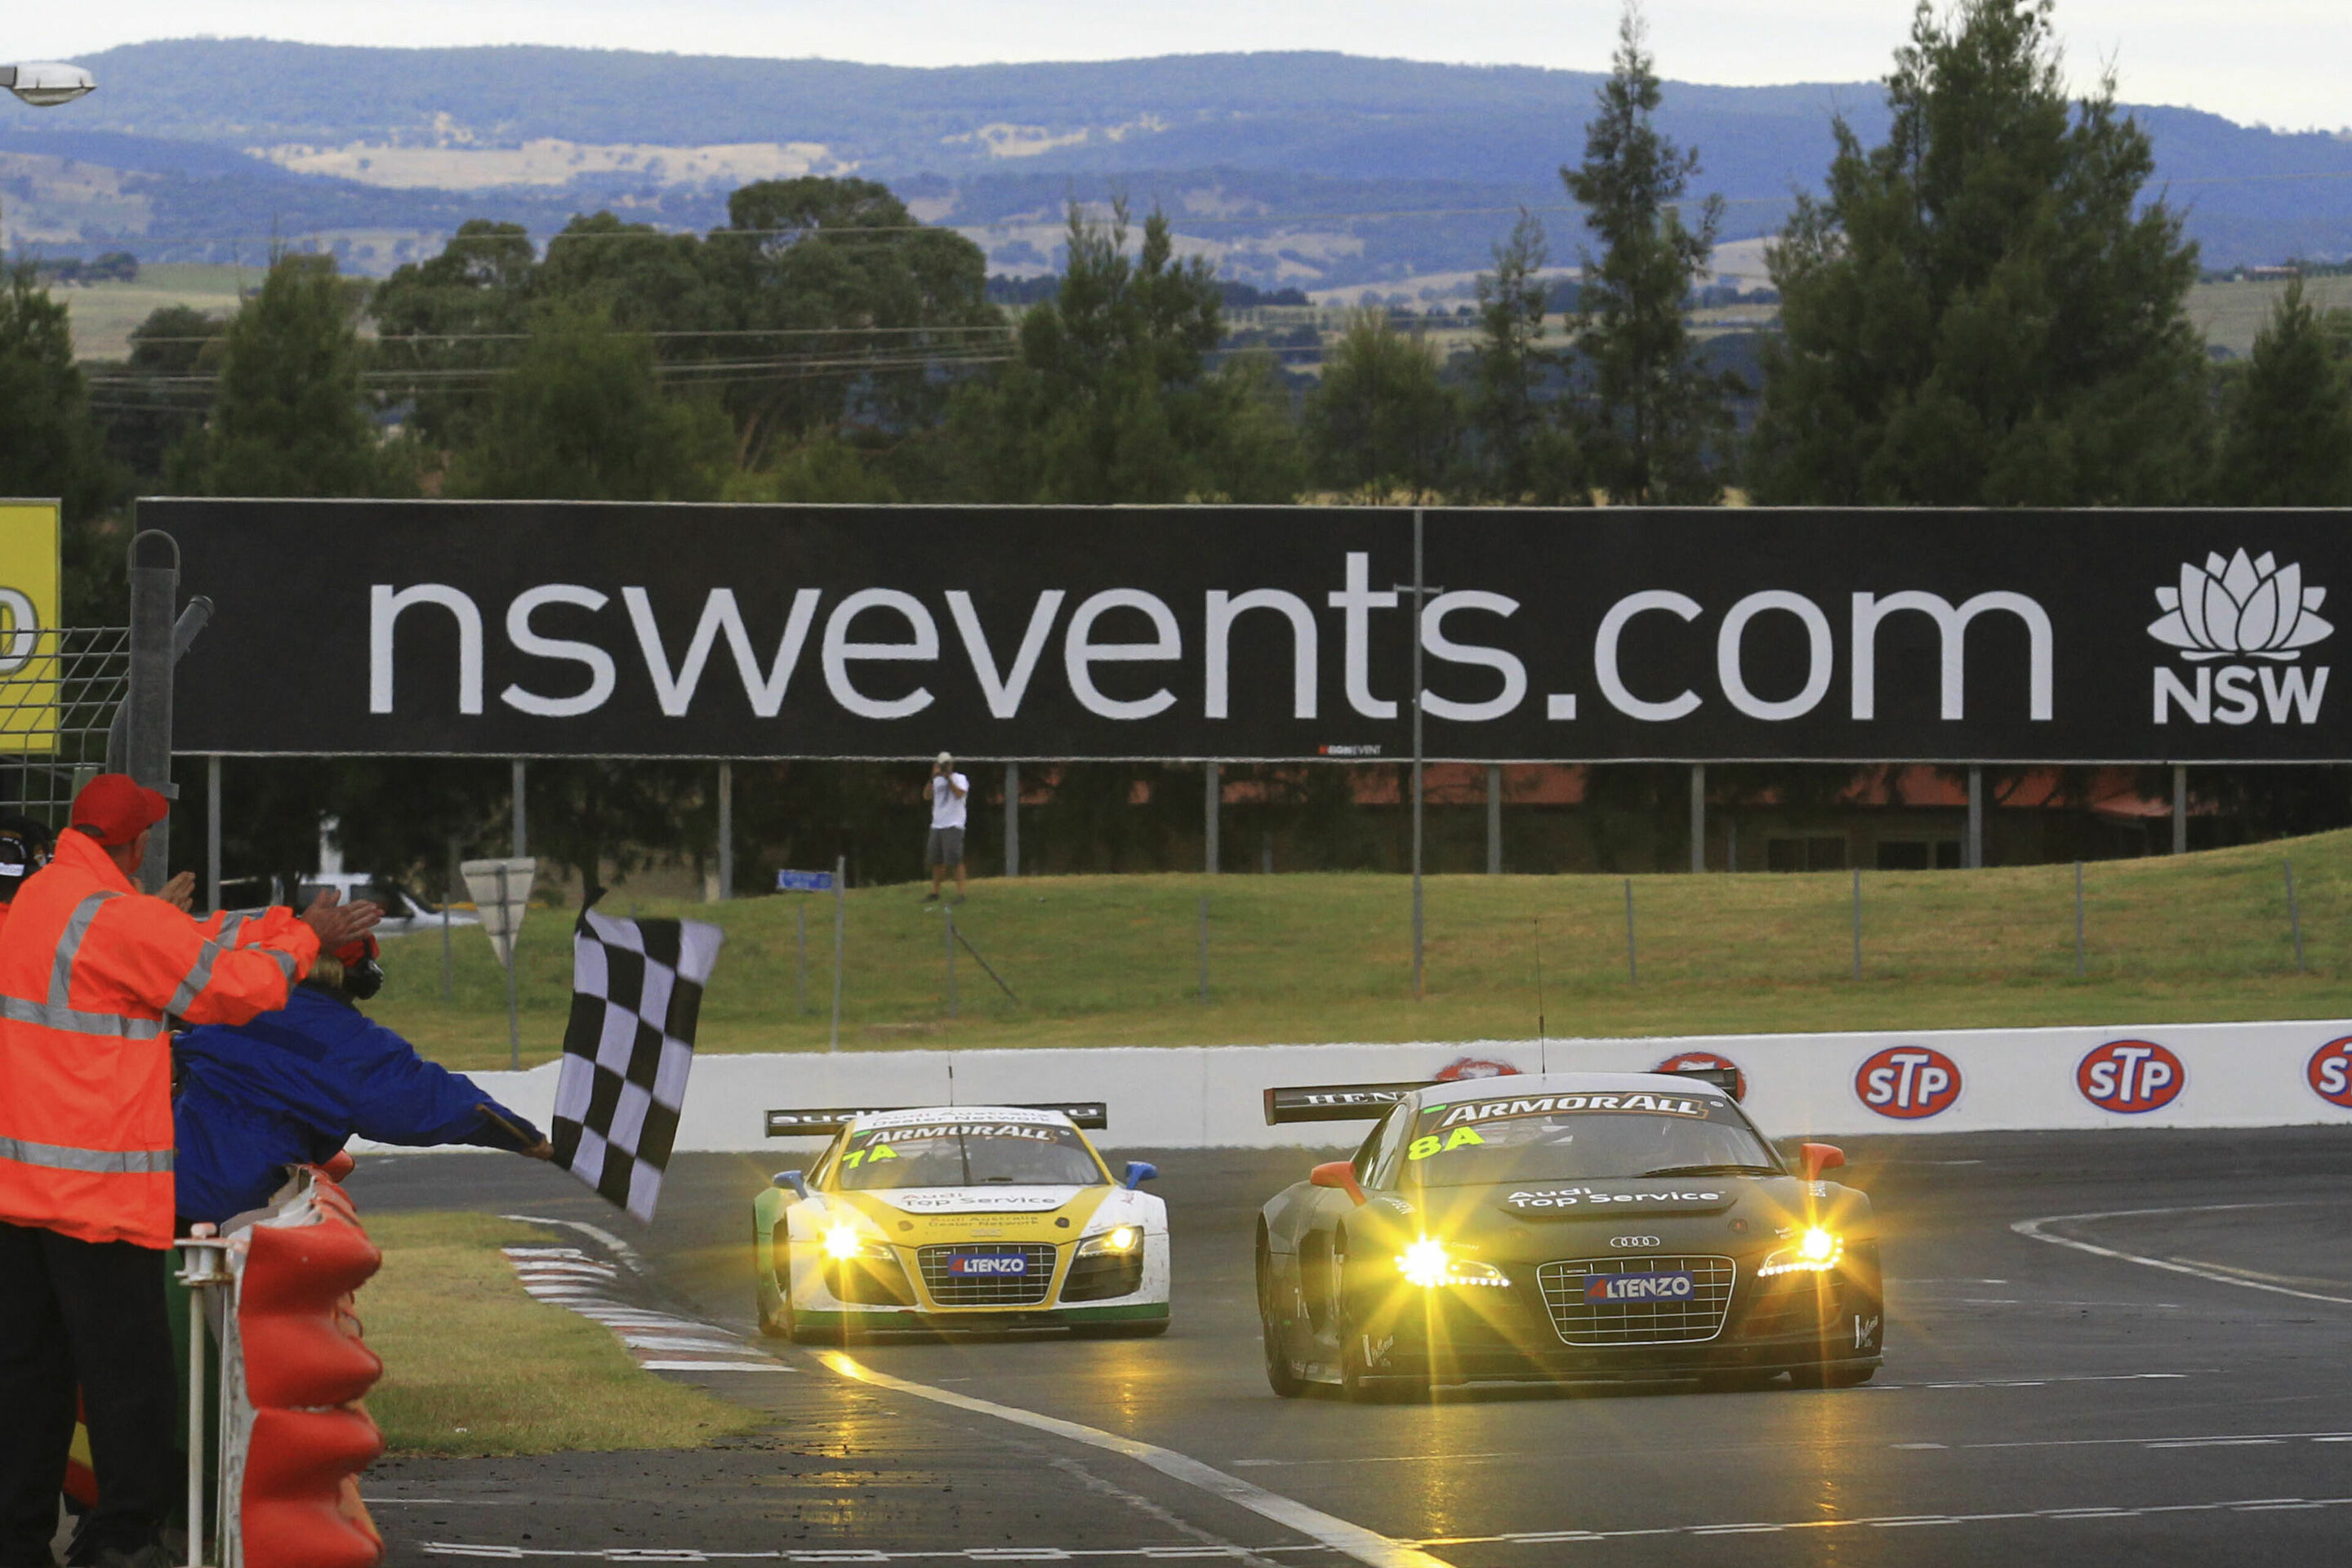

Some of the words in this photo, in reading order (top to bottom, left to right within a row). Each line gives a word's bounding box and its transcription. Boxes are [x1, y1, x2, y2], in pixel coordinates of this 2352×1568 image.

[368, 551, 2054, 722] nswevents.com
[2153, 664, 2331, 726] NSW
[1865, 1053, 1949, 1108] STP
[2088, 1047, 2172, 1102] STP
[843, 1144, 898, 1169] 7A
[1408, 1126, 1486, 1160] 8A
[901, 1192, 964, 1200] Audi
[901, 1199, 951, 1207] Top
[960, 1196, 1056, 1205] Service
[1508, 1187, 1592, 1200] Audi
[1508, 1196, 1578, 1208] Top
[1588, 1191, 1721, 1204] Service
